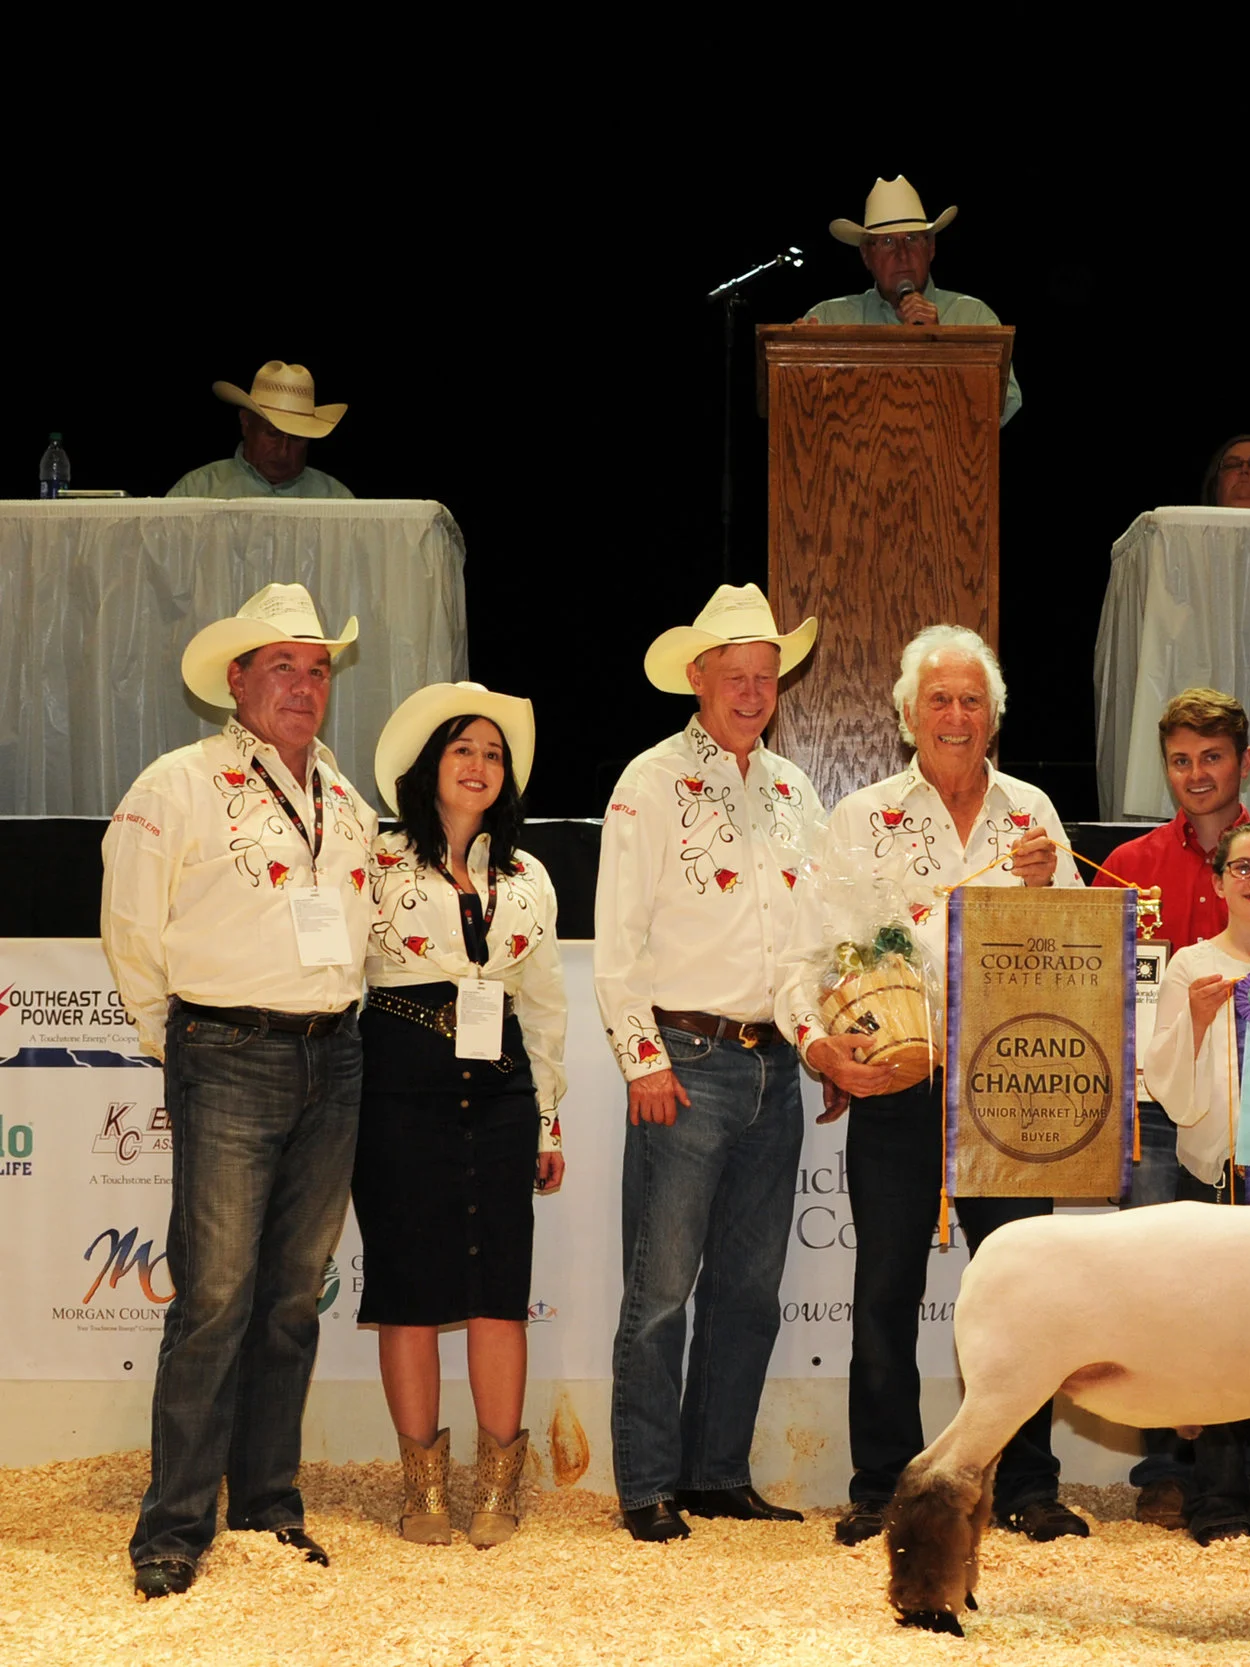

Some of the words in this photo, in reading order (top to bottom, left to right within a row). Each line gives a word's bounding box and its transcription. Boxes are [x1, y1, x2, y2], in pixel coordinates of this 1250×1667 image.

[1026, 938, 1056, 952] 2018
[981, 954, 1102, 971] COLORADO
[984, 972, 1042, 985] STATE
[1055, 973, 1099, 986] FAIR
[21, 1009, 83, 1026] POWER
[996, 1037, 1086, 1058] GRAND
[970, 1073, 1110, 1094] CHAMPION
[1021, 1108, 1070, 1118] MARKET
[1075, 1109, 1108, 1119] LAMB
[1021, 1132, 1060, 1142] BUYER
[102, 1175, 152, 1185] Touchstone
[52, 1308, 115, 1320] MORGAN
